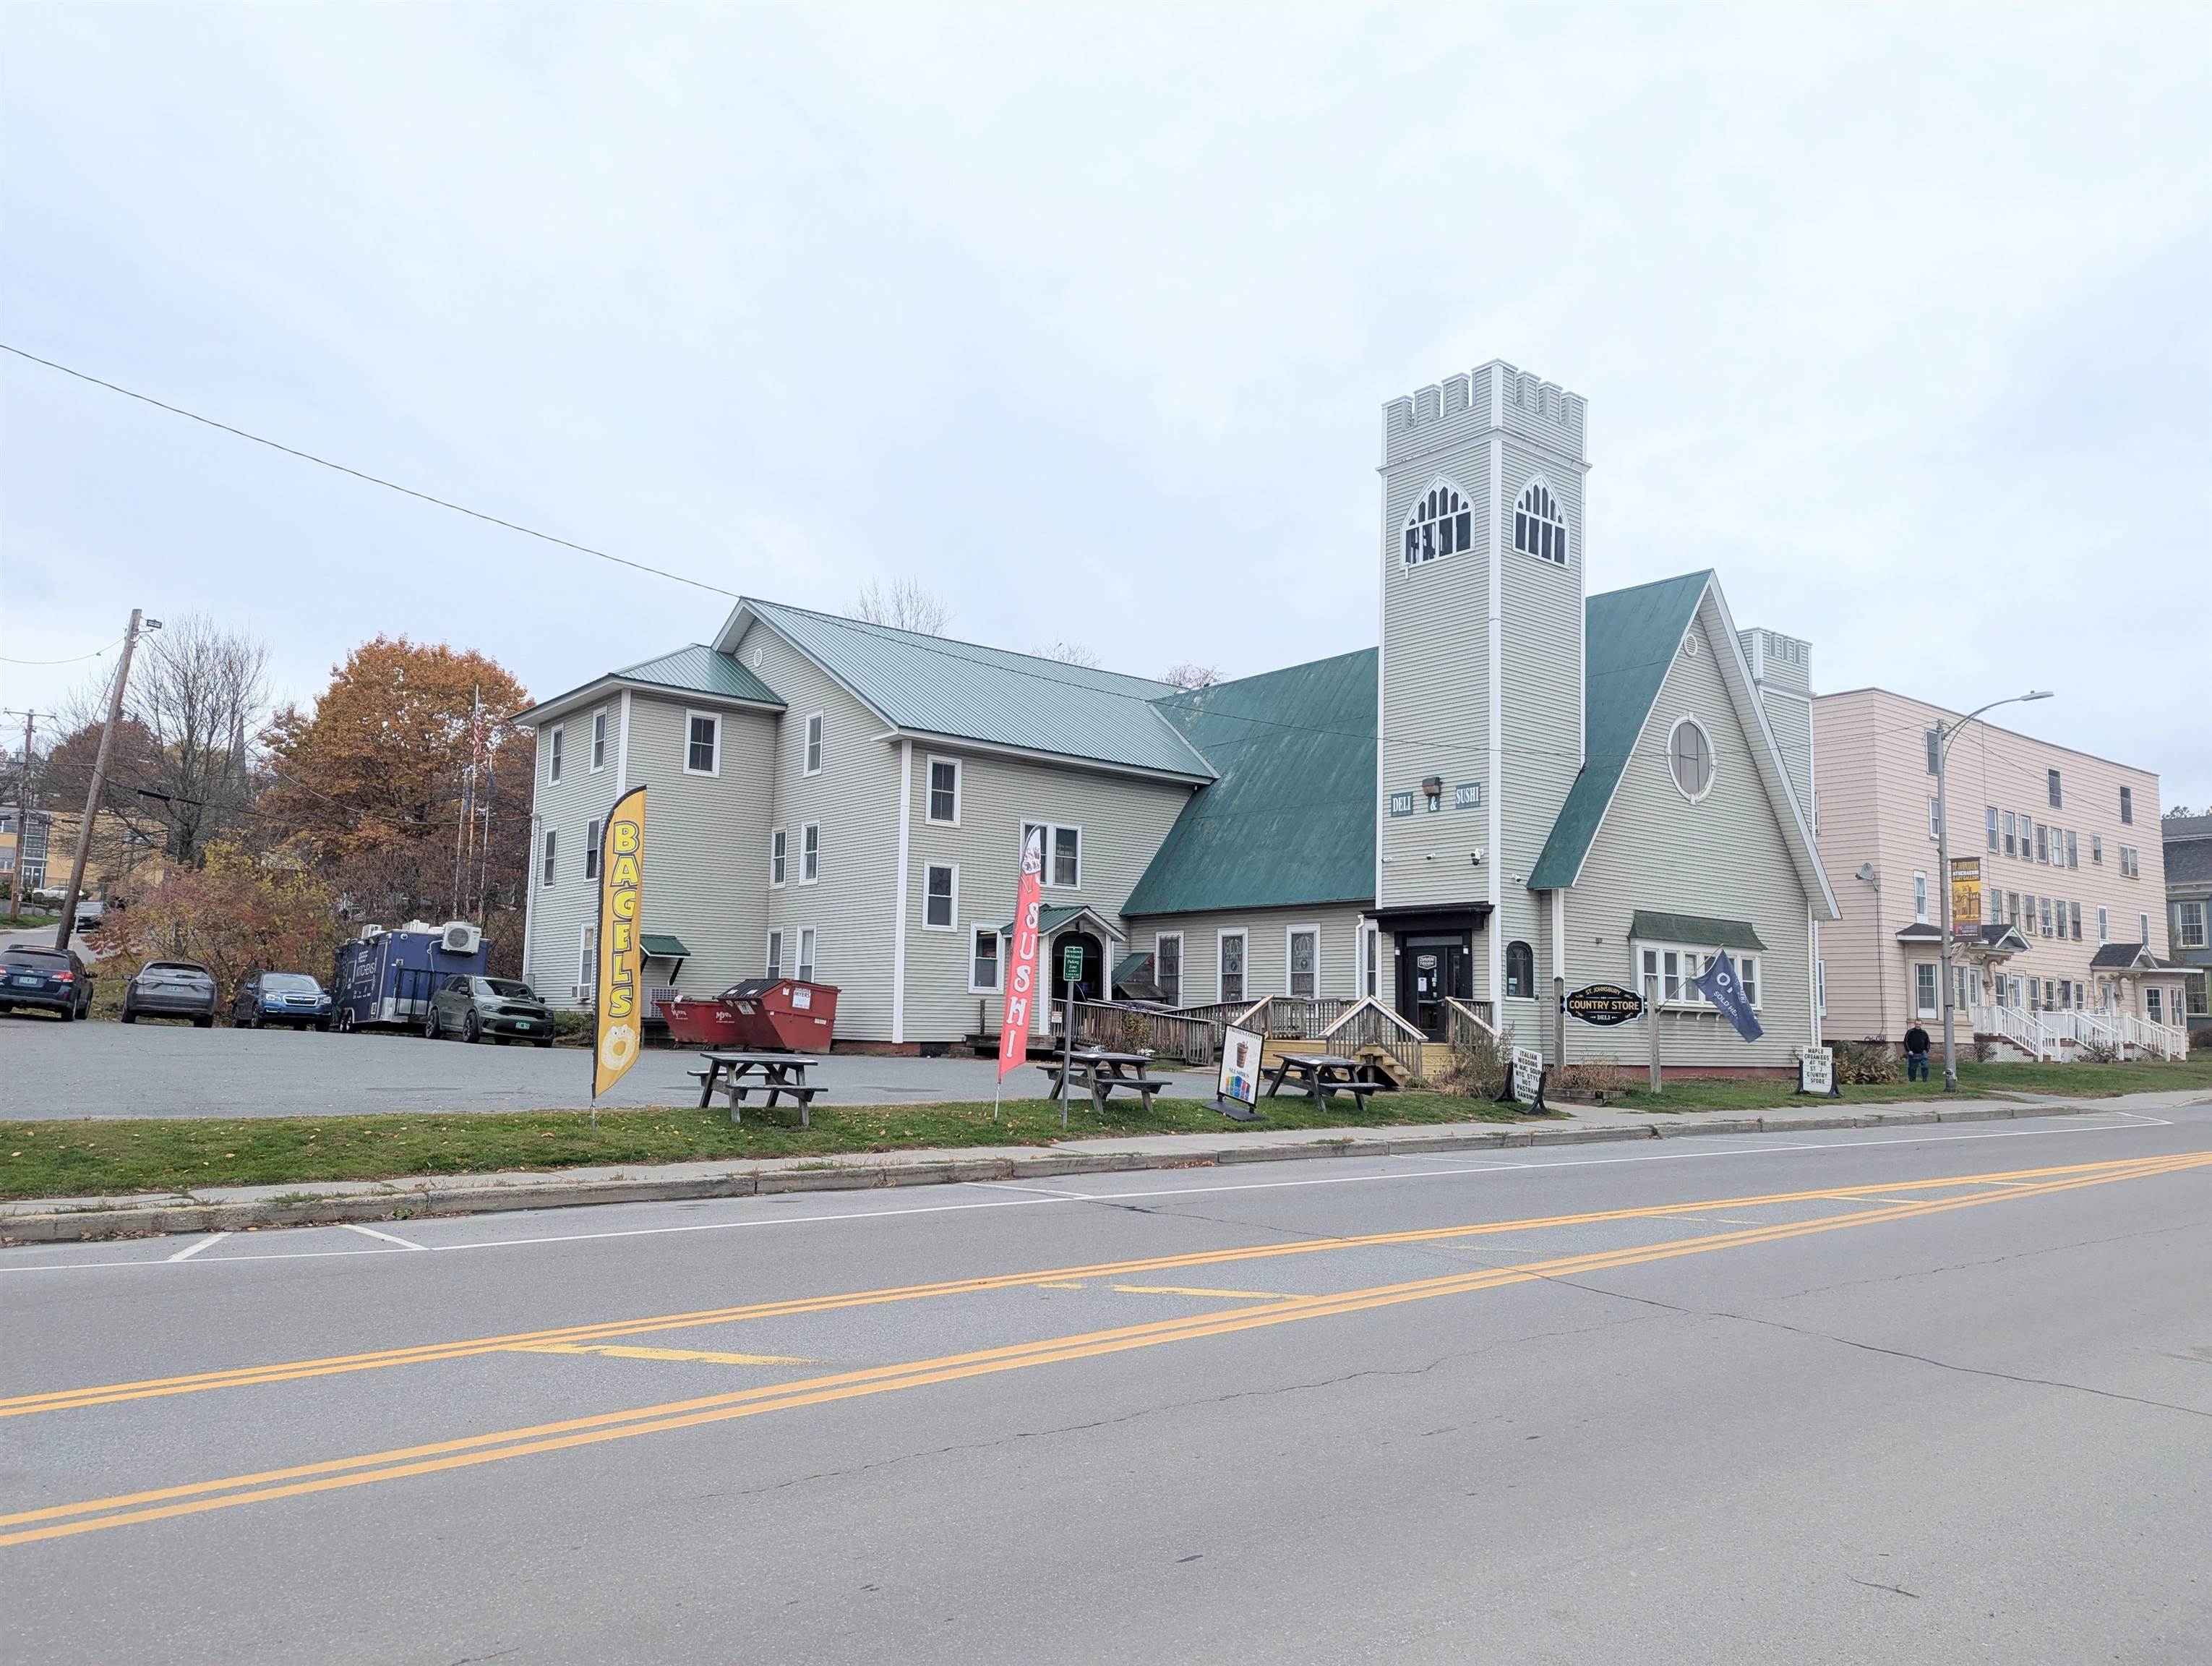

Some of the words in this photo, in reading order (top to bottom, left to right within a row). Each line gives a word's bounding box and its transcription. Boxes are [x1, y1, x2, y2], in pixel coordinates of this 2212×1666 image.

[1392, 796, 1411, 812] DELI
[1430, 796, 1437, 811] &
[1456, 787, 1480, 804] SUSHI
[609, 821, 640, 1019] BAGELS
[1006, 902, 1039, 1059] SUSHI
[1592, 986, 1621, 995] JOHNSBURY
[1569, 1000, 1609, 1009] COUNTRY
[1611, 1001, 1639, 1010] STORE
[1713, 991, 1730, 1007] SOLD
